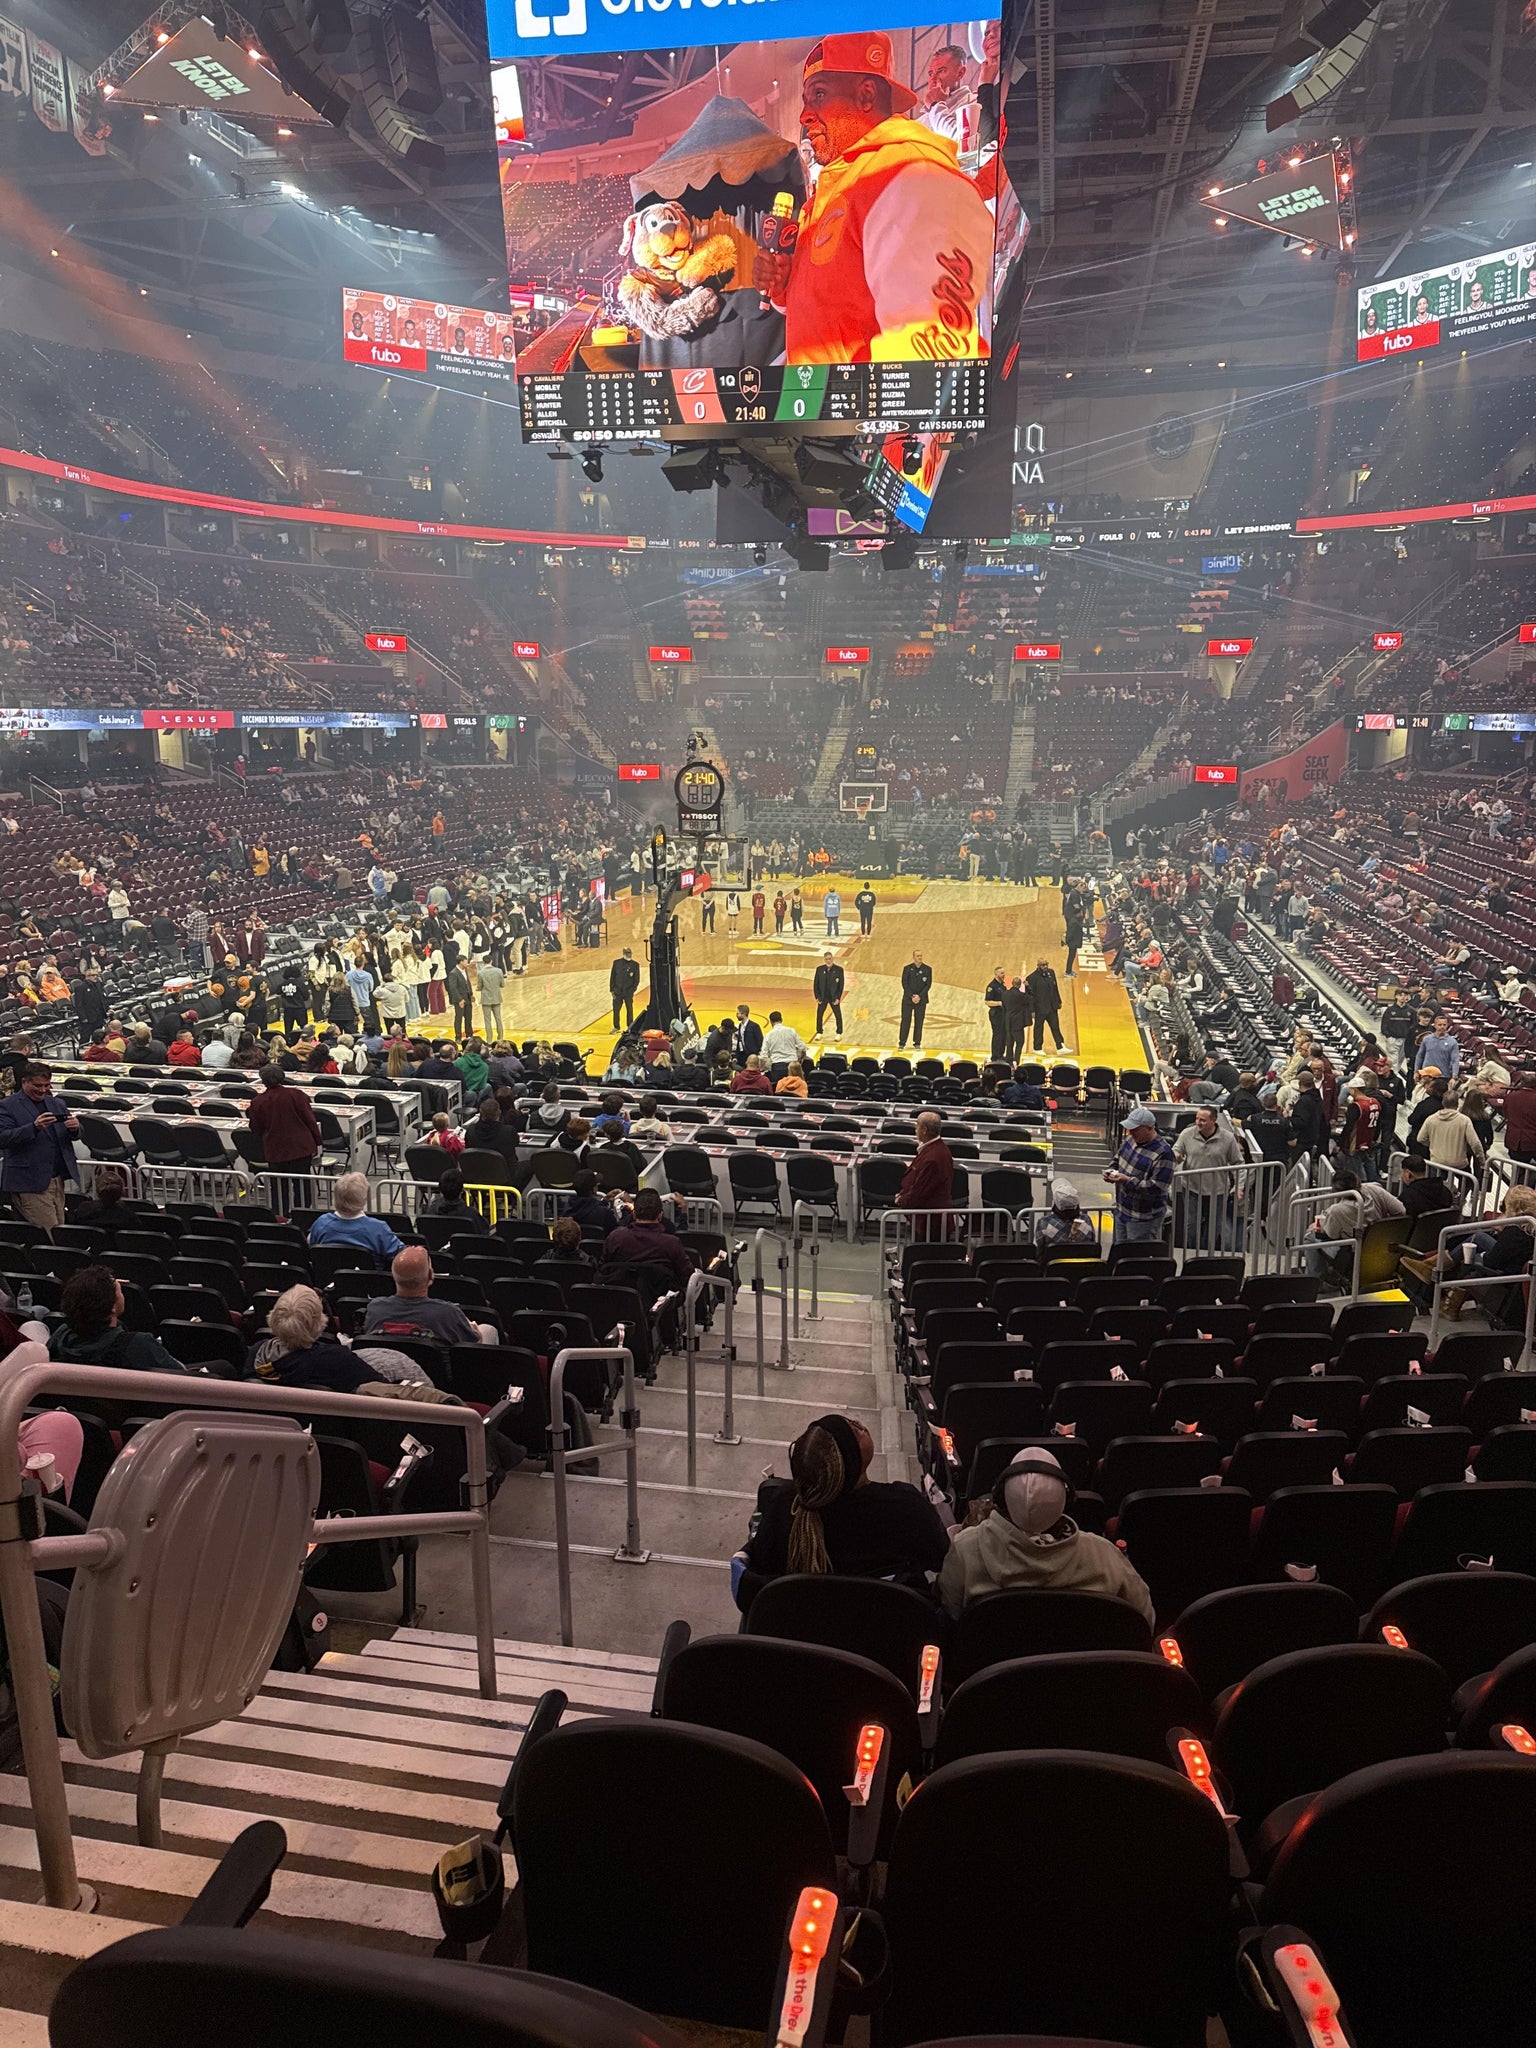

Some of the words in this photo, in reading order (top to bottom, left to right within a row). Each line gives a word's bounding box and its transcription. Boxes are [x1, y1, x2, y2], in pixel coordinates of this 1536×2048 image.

[169, 59, 231, 100] KNOW.
[193, 55, 233, 78] LET
[221, 76, 251, 95] EM
[1258, 194, 1292, 212] LET
[1295, 185, 1320, 201] EM
[1264, 195, 1331, 222] KNOW.
[1383, 335, 1413, 351] fubo
[371, 346, 401, 364] fubo
[720, 375, 736, 386] 1Q
[844, 372, 850, 380] 0
[651, 378, 656, 386] 0
[694, 402, 706, 419] 0
[736, 406, 766, 421] 21:40
[794, 399, 806, 417] 0
[862, 420, 900, 434] $4,994
[919, 420, 985, 430] CAVS5050.COM
[532, 429, 560, 440] oswald
[616, 429, 661, 440] RAFFLE
[64, 466, 80, 481] Turn
[1472, 504, 1491, 513] Turn
[418, 523, 435, 534] Turn
[1184, 529, 1199, 538] 6:43
[1200, 528, 1212, 536] PM
[1224, 526, 1244, 535] LET
[1244, 525, 1259, 534] EM
[1259, 523, 1292, 532] KNOW.
[1055, 535, 1073, 543] FG%
[1079, 534, 1085, 543] 0
[1099, 533, 1123, 541] FOULS
[1129, 532, 1136, 541] 0
[1147, 531, 1162, 539] TOL
[1168, 530, 1174, 539] 7
[376, 637, 396, 650] fubo
[1220, 642, 1240, 652] fubo
[517, 644, 536, 657] fubo
[661, 648, 680, 659] fubo
[839, 650, 858, 660] fubo
[1028, 647, 1048, 657] fubo
[99, 715, 112, 724] Ends
[112, 715, 130, 725] January
[161, 715, 217, 723] LEXUS
[242, 715, 268, 724] DECEMBER
[268, 716, 275, 724] TO
[276, 716, 300, 724] REMEMBER
[490, 717, 496, 726] 0
[1305, 756, 1328, 768] SEAT
[631, 768, 648, 777] fubo
[685, 772, 715, 784] 21:40
[1208, 770, 1225, 780] fubo
[1303, 768, 1328, 781] GEEK
